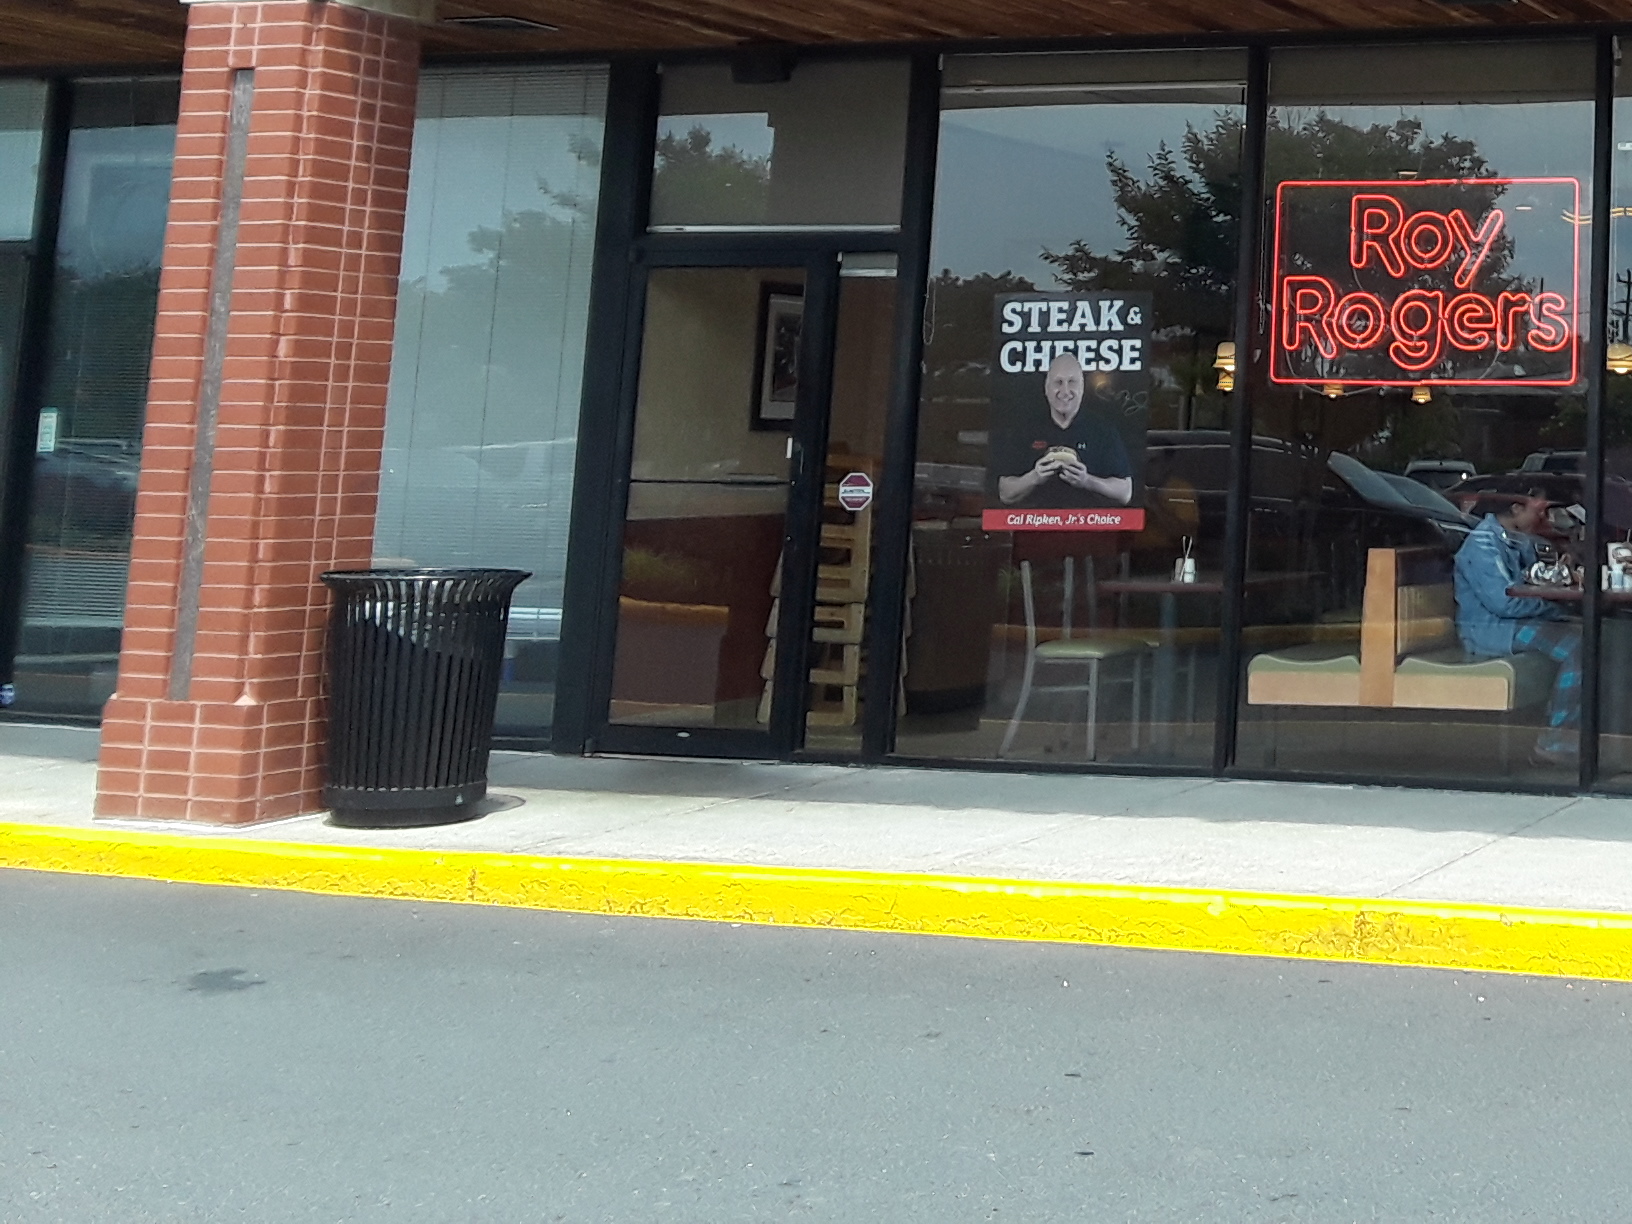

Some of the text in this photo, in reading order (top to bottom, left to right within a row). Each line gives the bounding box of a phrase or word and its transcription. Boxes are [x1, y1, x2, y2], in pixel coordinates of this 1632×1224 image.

[1350, 194, 1504, 288] Roy
[1001, 299, 1142, 334] STEAK &
[1282, 276, 1570, 370] Rogers
[1006, 513, 1024, 525] Cal
[1026, 513, 1063, 527] Ripken,
[1087, 513, 1121, 525] Choice
